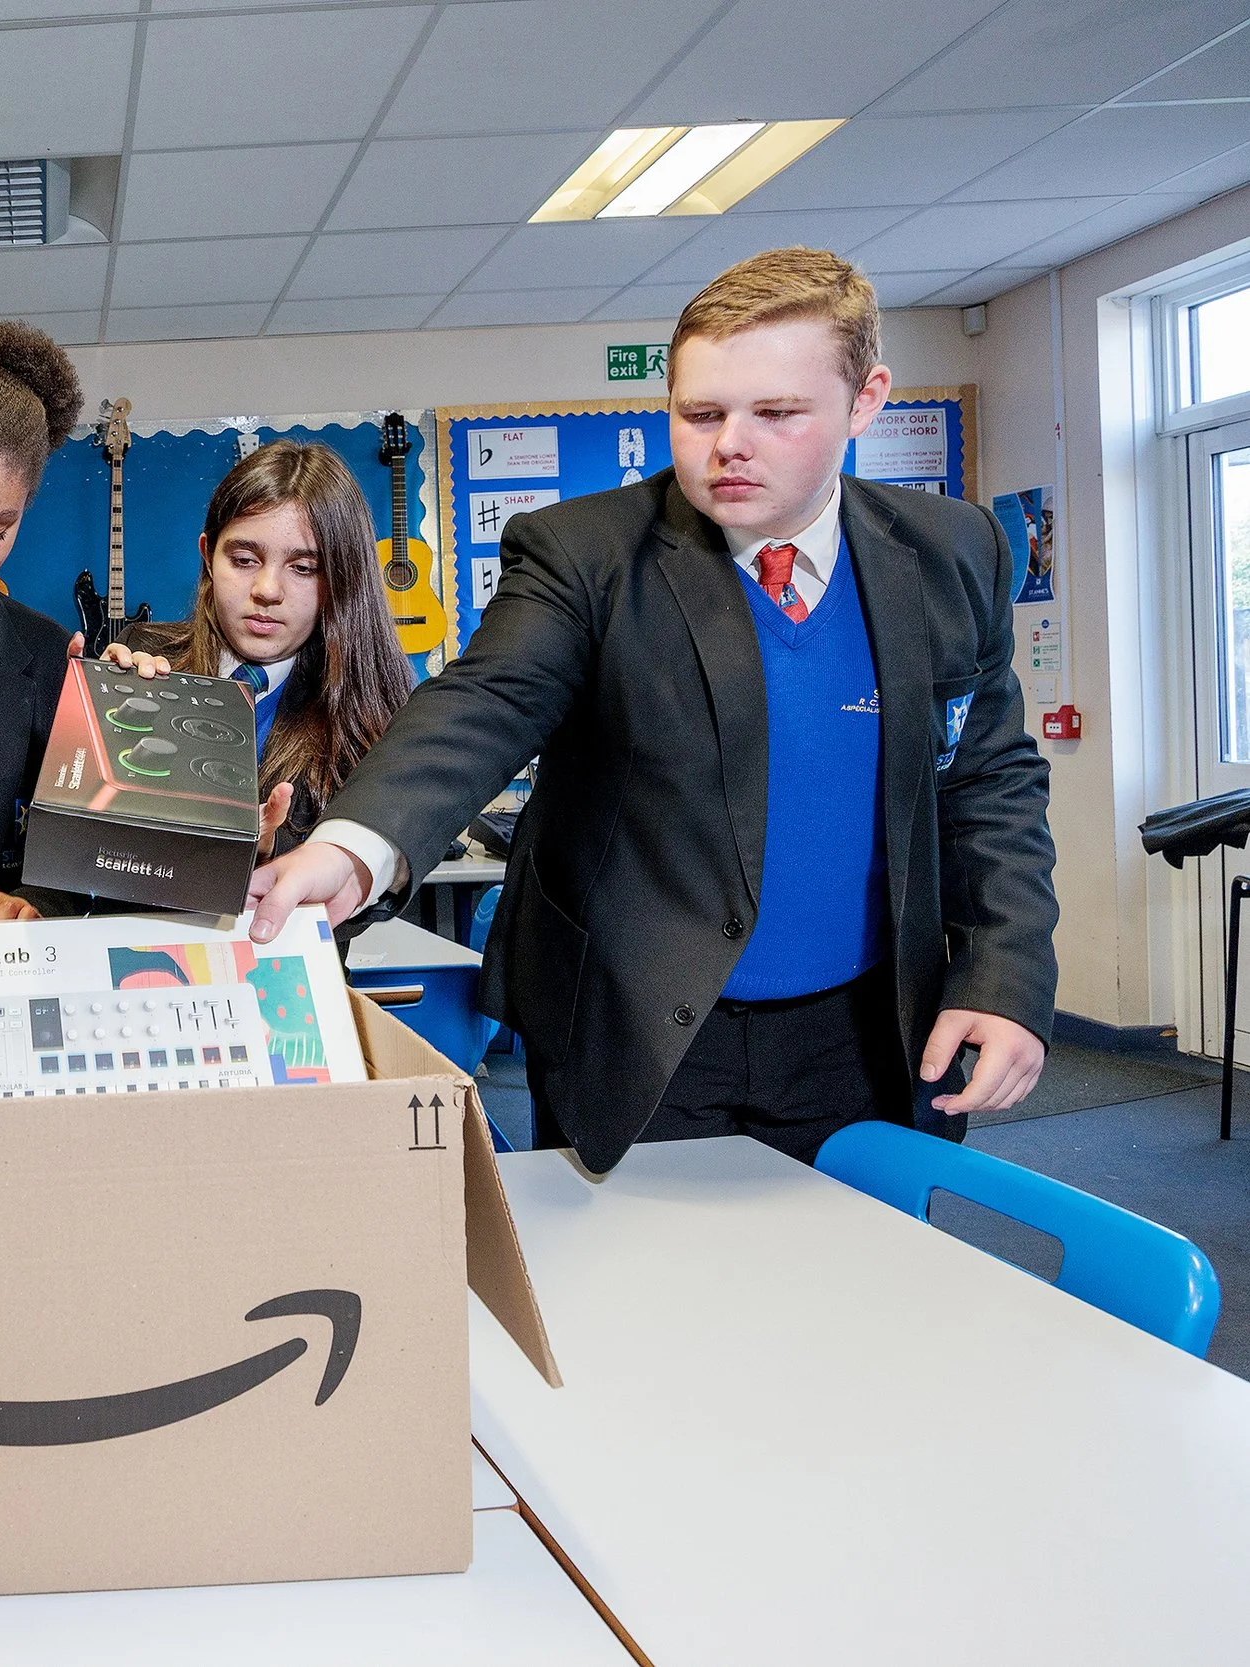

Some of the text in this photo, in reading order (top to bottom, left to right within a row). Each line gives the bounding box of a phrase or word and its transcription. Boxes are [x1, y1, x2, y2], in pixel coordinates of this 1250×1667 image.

[609, 349, 638, 362] Fire
[609, 364, 638, 377] exit
[876, 415, 938, 425] WORK OUT A
[503, 432, 524, 441] FLAT
[902, 427, 938, 436] CHORD
[504, 495, 535, 505] SHARP
[98, 846, 139, 860] Focusrite
[96, 856, 175, 879] Scarlett 4i4
[45, 945, 58, 962] 3
[8, 967, 56, 978] Controller
[218, 1069, 253, 1078] ARTURIA
